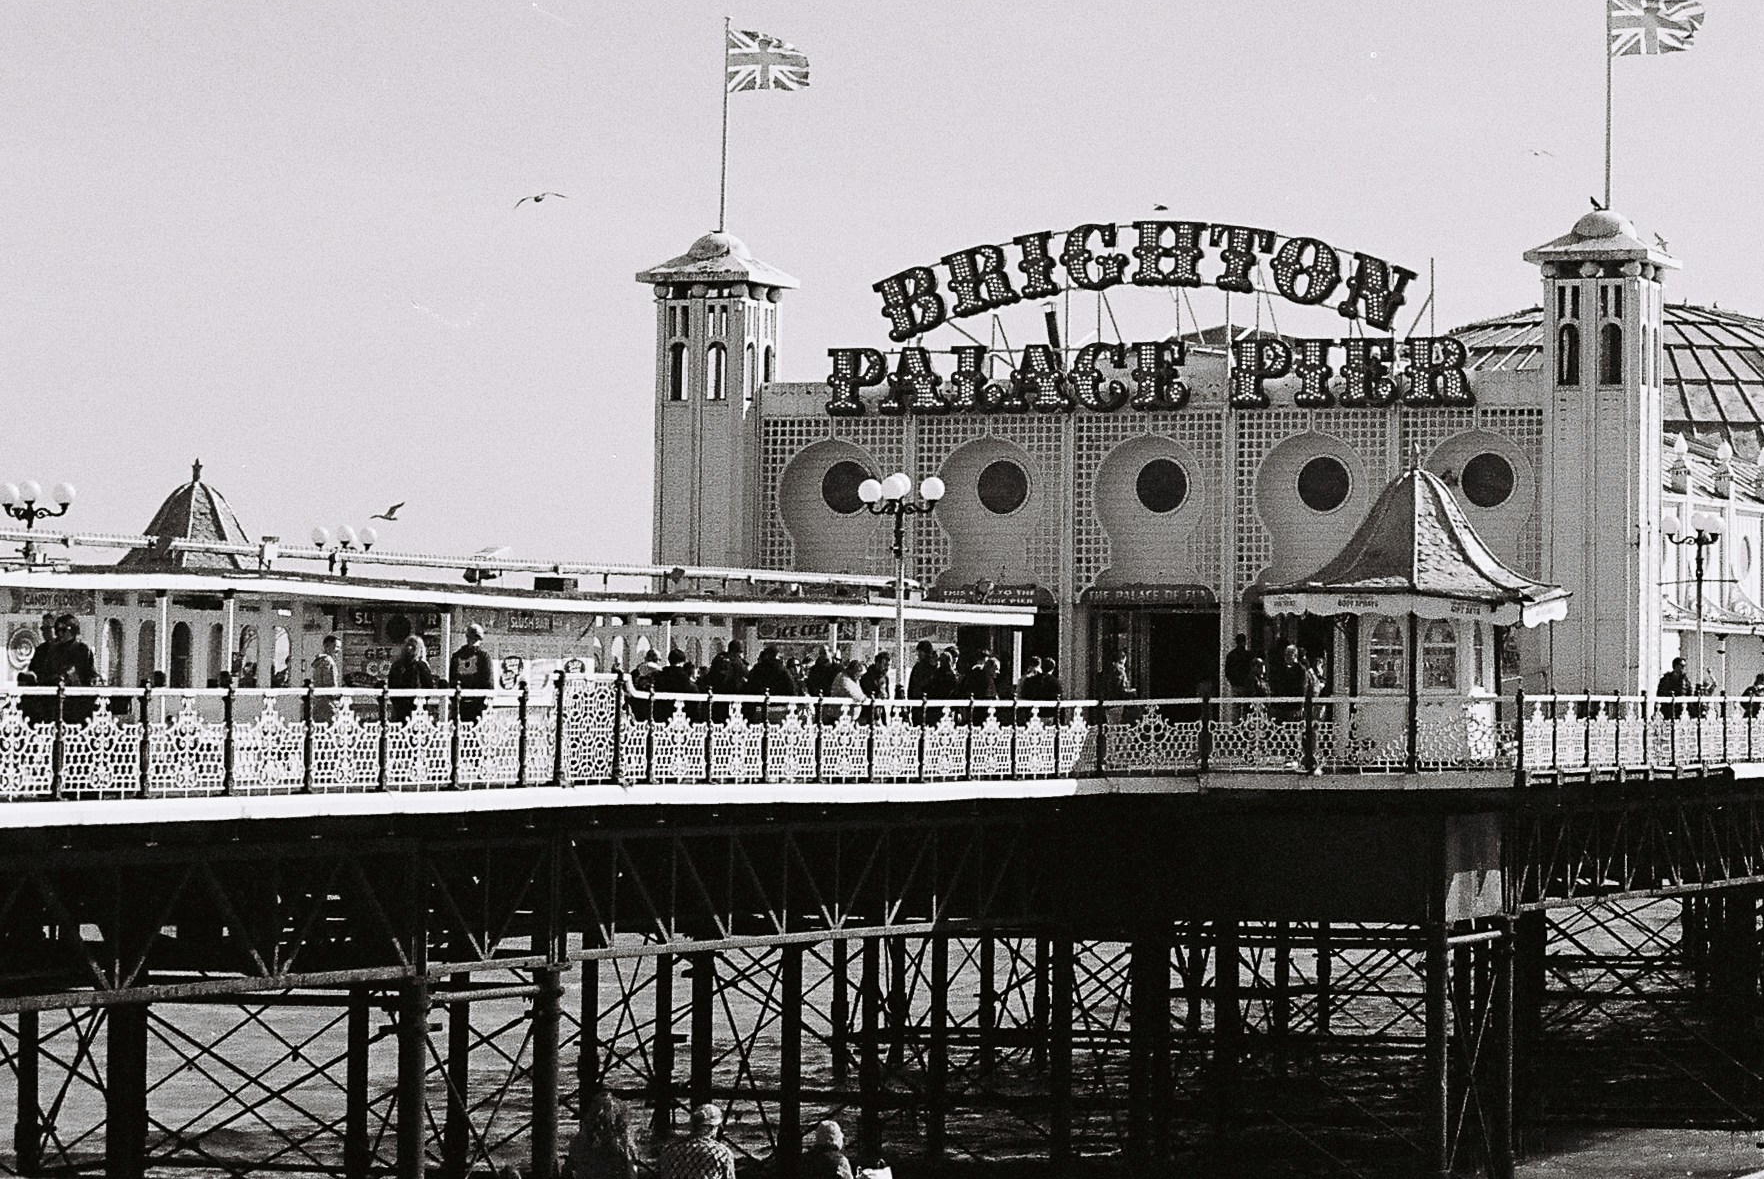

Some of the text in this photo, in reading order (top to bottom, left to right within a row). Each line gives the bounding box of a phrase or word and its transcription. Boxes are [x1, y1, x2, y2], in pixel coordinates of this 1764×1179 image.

[872, 220, 1419, 342] BRIGHTON
[825, 335, 1478, 416] PALACE PIER
[23, 593, 52, 606] CANDY
[998, 589, 1013, 597] TO
[1016, 589, 1036, 597] THE
[1088, 589, 1110, 600] THE
[1115, 589, 1160, 600] PALACE
[1164, 589, 1180, 600] OF
[510, 616, 550, 630] SLUSH BAR
[776, 625, 798, 639] ICE
[364, 646, 393, 660] GET
